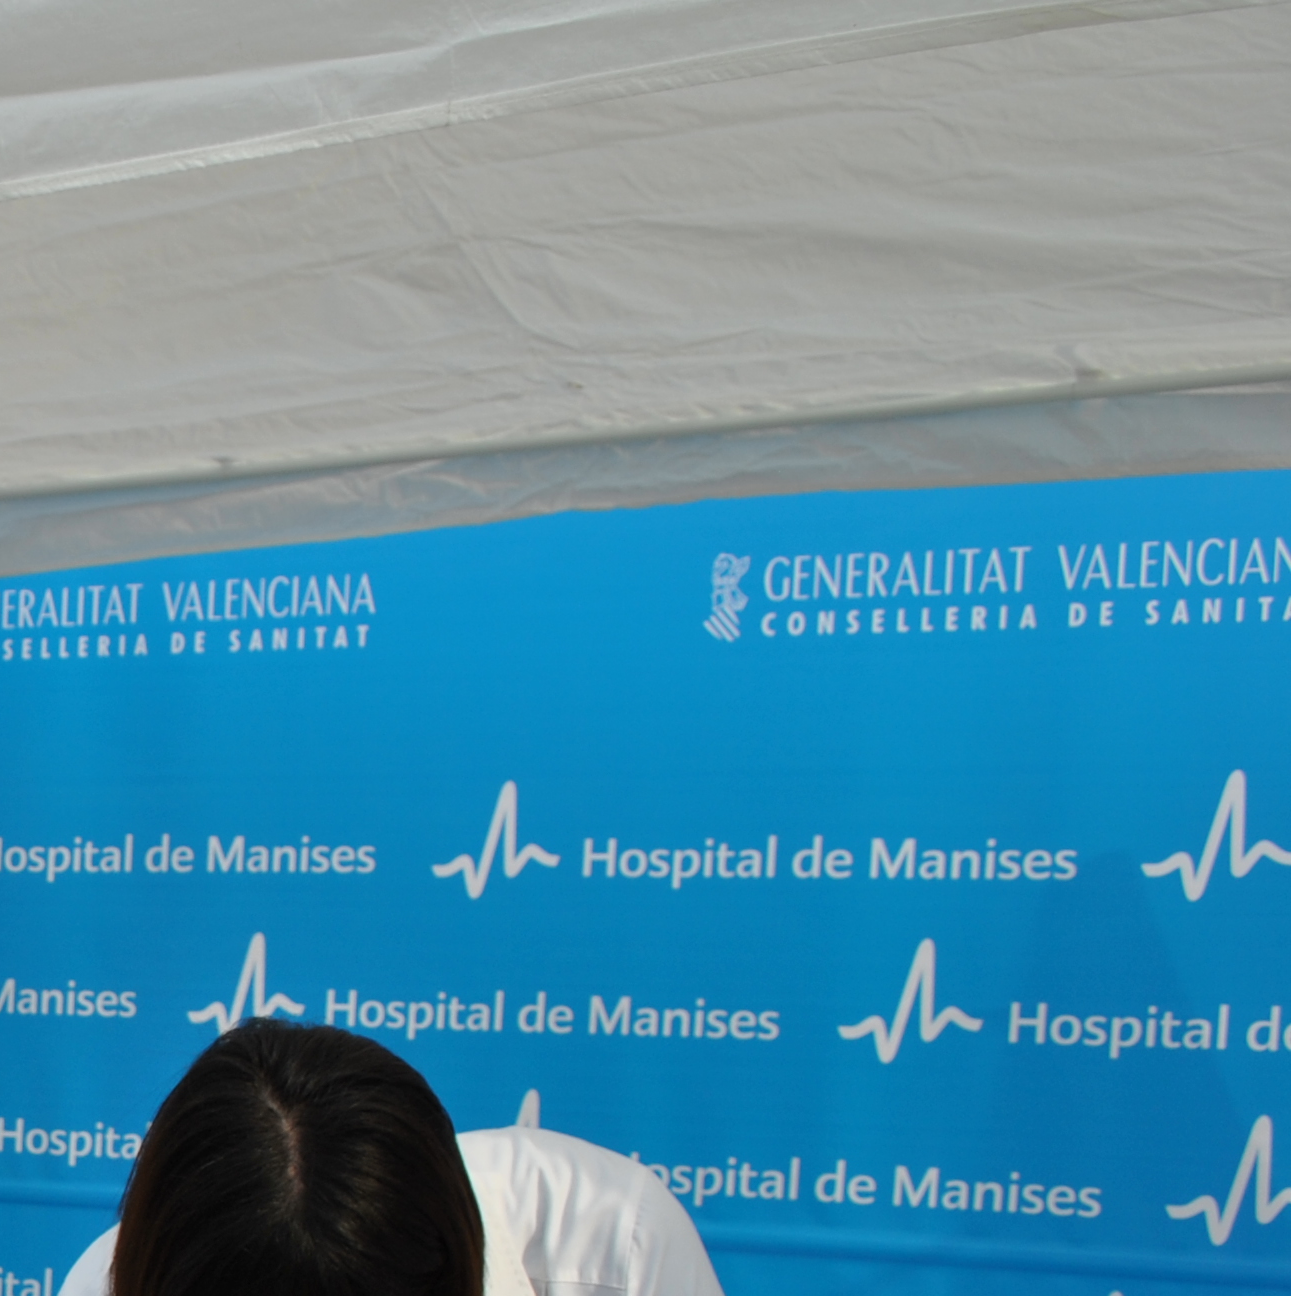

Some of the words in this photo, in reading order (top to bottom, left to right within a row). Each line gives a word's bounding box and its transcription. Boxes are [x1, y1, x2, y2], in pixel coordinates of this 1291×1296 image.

[161, 572, 377, 623] VALENCIANA
[763, 544, 1032, 602] GENERALITAT
[170, 630, 207, 655] DE
[228, 624, 372, 652] SANITAT
[760, 603, 1037, 637] CONSELLERIA
[1067, 600, 1115, 628] DE
[144, 832, 194, 873] de
[206, 833, 376, 874] Manises
[581, 833, 778, 890] Hospital
[791, 833, 854, 880] de
[868, 836, 1078, 882] Manises
[325, 988, 506, 1041] Hospital
[517, 990, 575, 1034] de
[587, 995, 781, 1041] Manises
[1007, 1001, 1229, 1059] Hospital
[630, 1151, 802, 1207] ospital
[814, 1159, 877, 1206] de
[892, 1164, 1103, 1219] Manises
